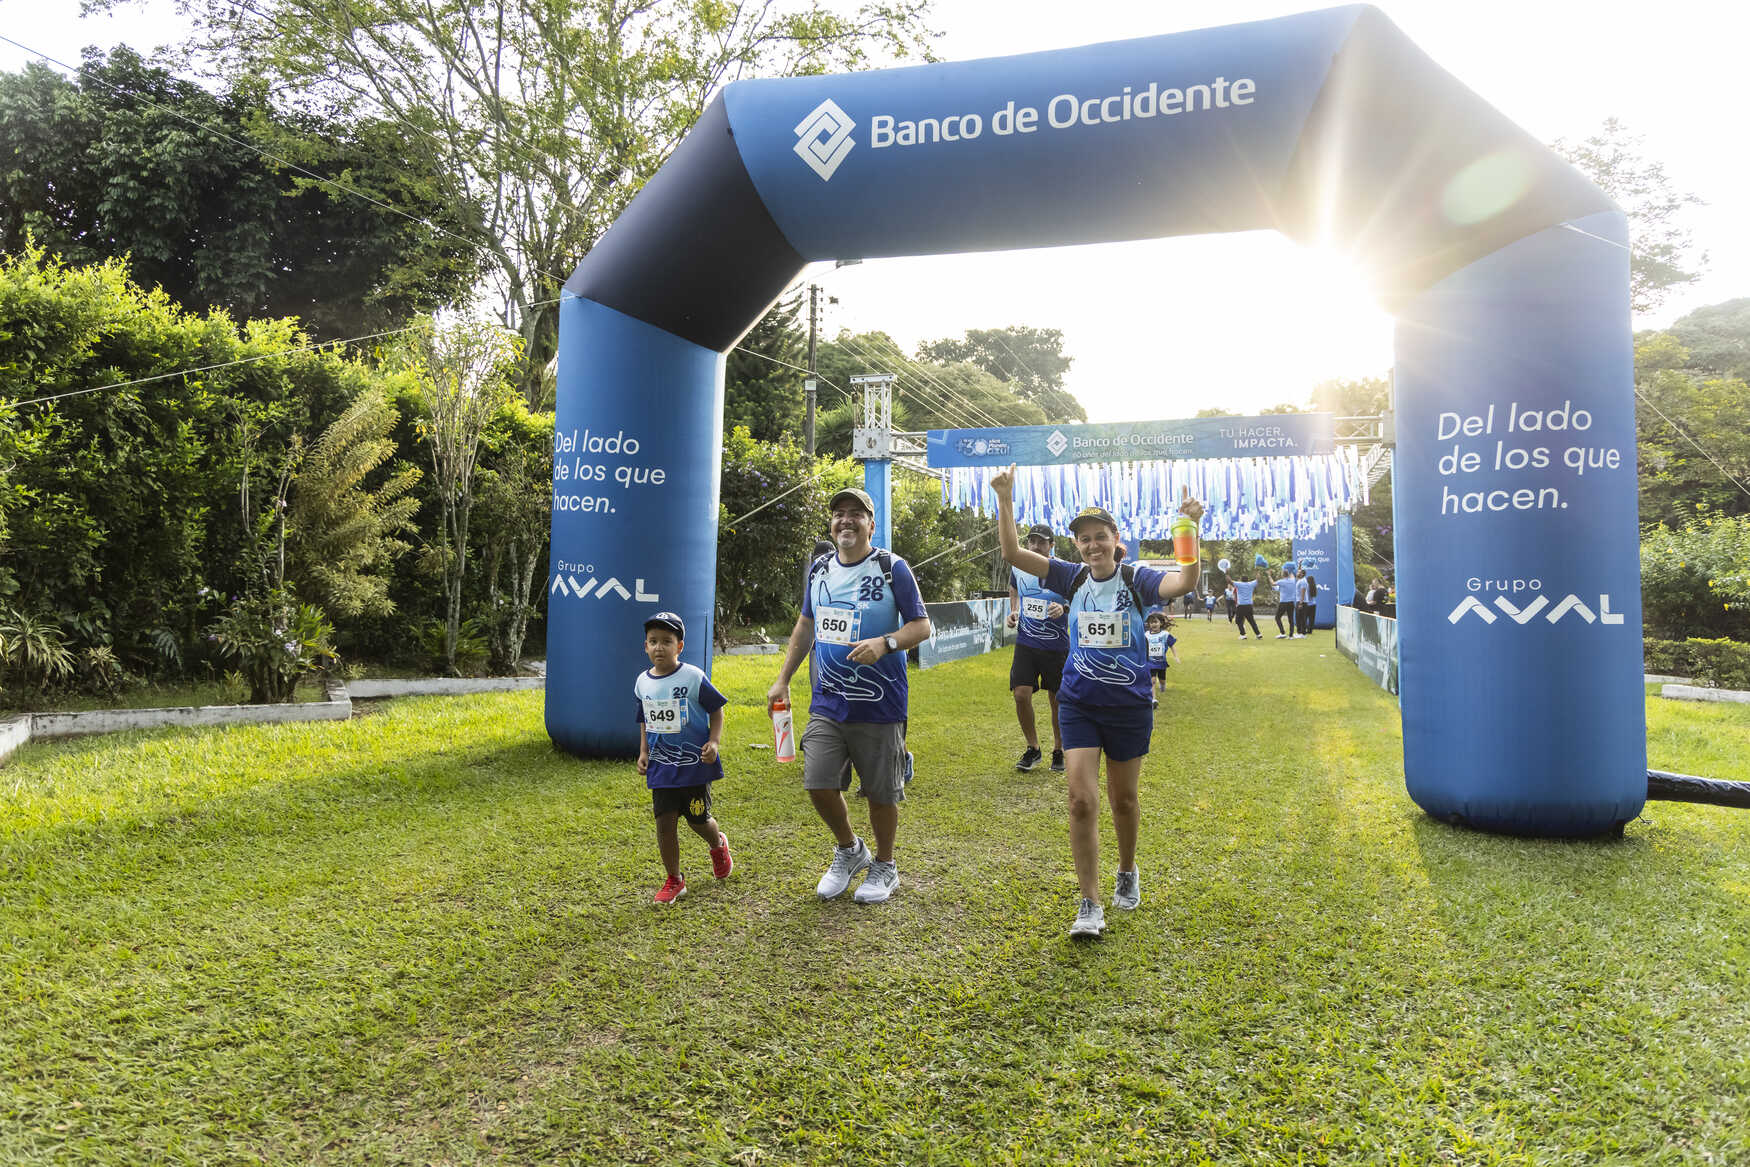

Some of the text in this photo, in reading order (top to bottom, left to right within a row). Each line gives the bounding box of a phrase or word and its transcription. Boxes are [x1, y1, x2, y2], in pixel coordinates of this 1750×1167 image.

[871, 75, 1257, 149] Banco de Occidente
[1437, 400, 1593, 441] Del lado
[1073, 433, 1195, 448] Banco de Occidente
[1219, 426, 1285, 439] TU HACER.
[555, 429, 640, 455] Del lado
[1233, 438, 1298, 449] IMPACTA.
[1438, 440, 1621, 476] de los que
[554, 457, 666, 489] de los que
[553, 488, 616, 513] hacen.
[1441, 486, 1568, 515] hacen.
[557, 559, 595, 575] Grupo
[551, 574, 660, 602] AVAL
[861, 576, 885, 589] 20
[1466, 577, 1542, 593] Grupo
[859, 588, 884, 601] 26
[1027, 603, 1043, 613] 255
[1448, 594, 1625, 625] AVAL
[822, 618, 848, 632] 650
[1088, 622, 1115, 636] 651
[673, 686, 688, 697] 20
[650, 709, 675, 722] 649
